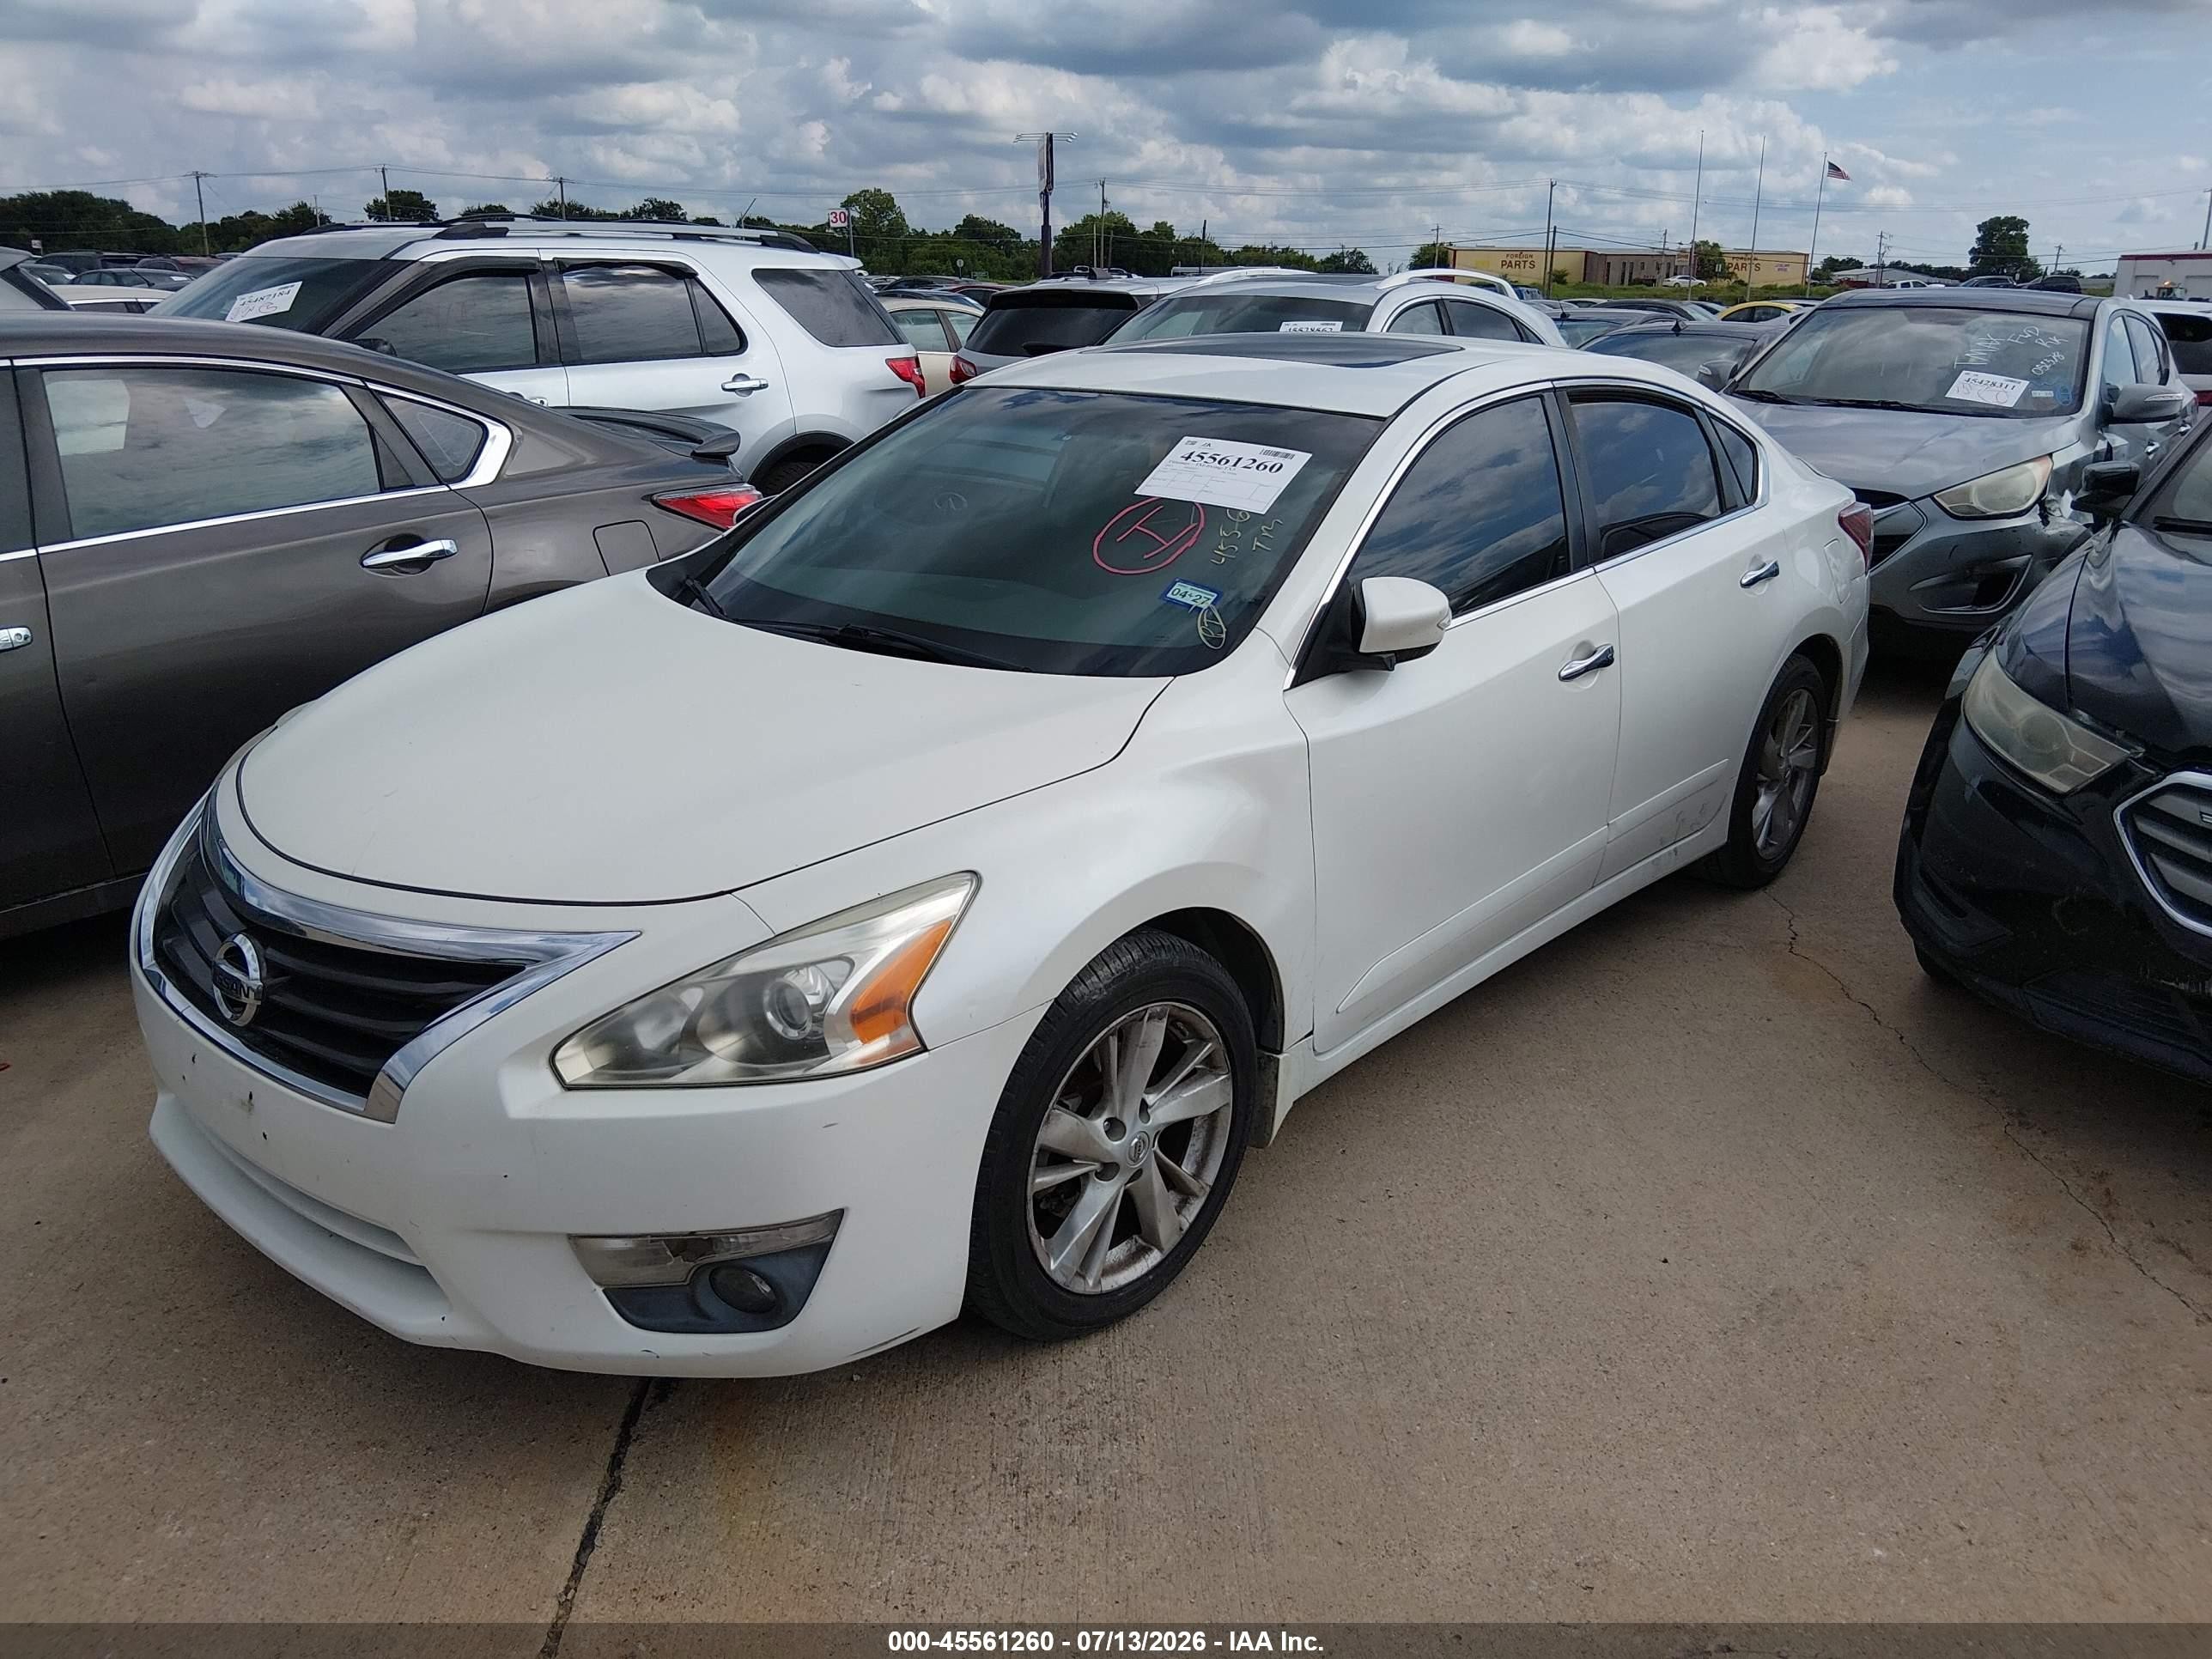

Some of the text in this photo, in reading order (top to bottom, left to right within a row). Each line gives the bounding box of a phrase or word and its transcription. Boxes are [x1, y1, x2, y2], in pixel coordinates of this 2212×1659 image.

[830, 211, 847, 224] 30
[1501, 259, 1536, 270] PARTS
[1964, 377, 2016, 391] 45428311
[1180, 450, 1284, 474] 45561260
